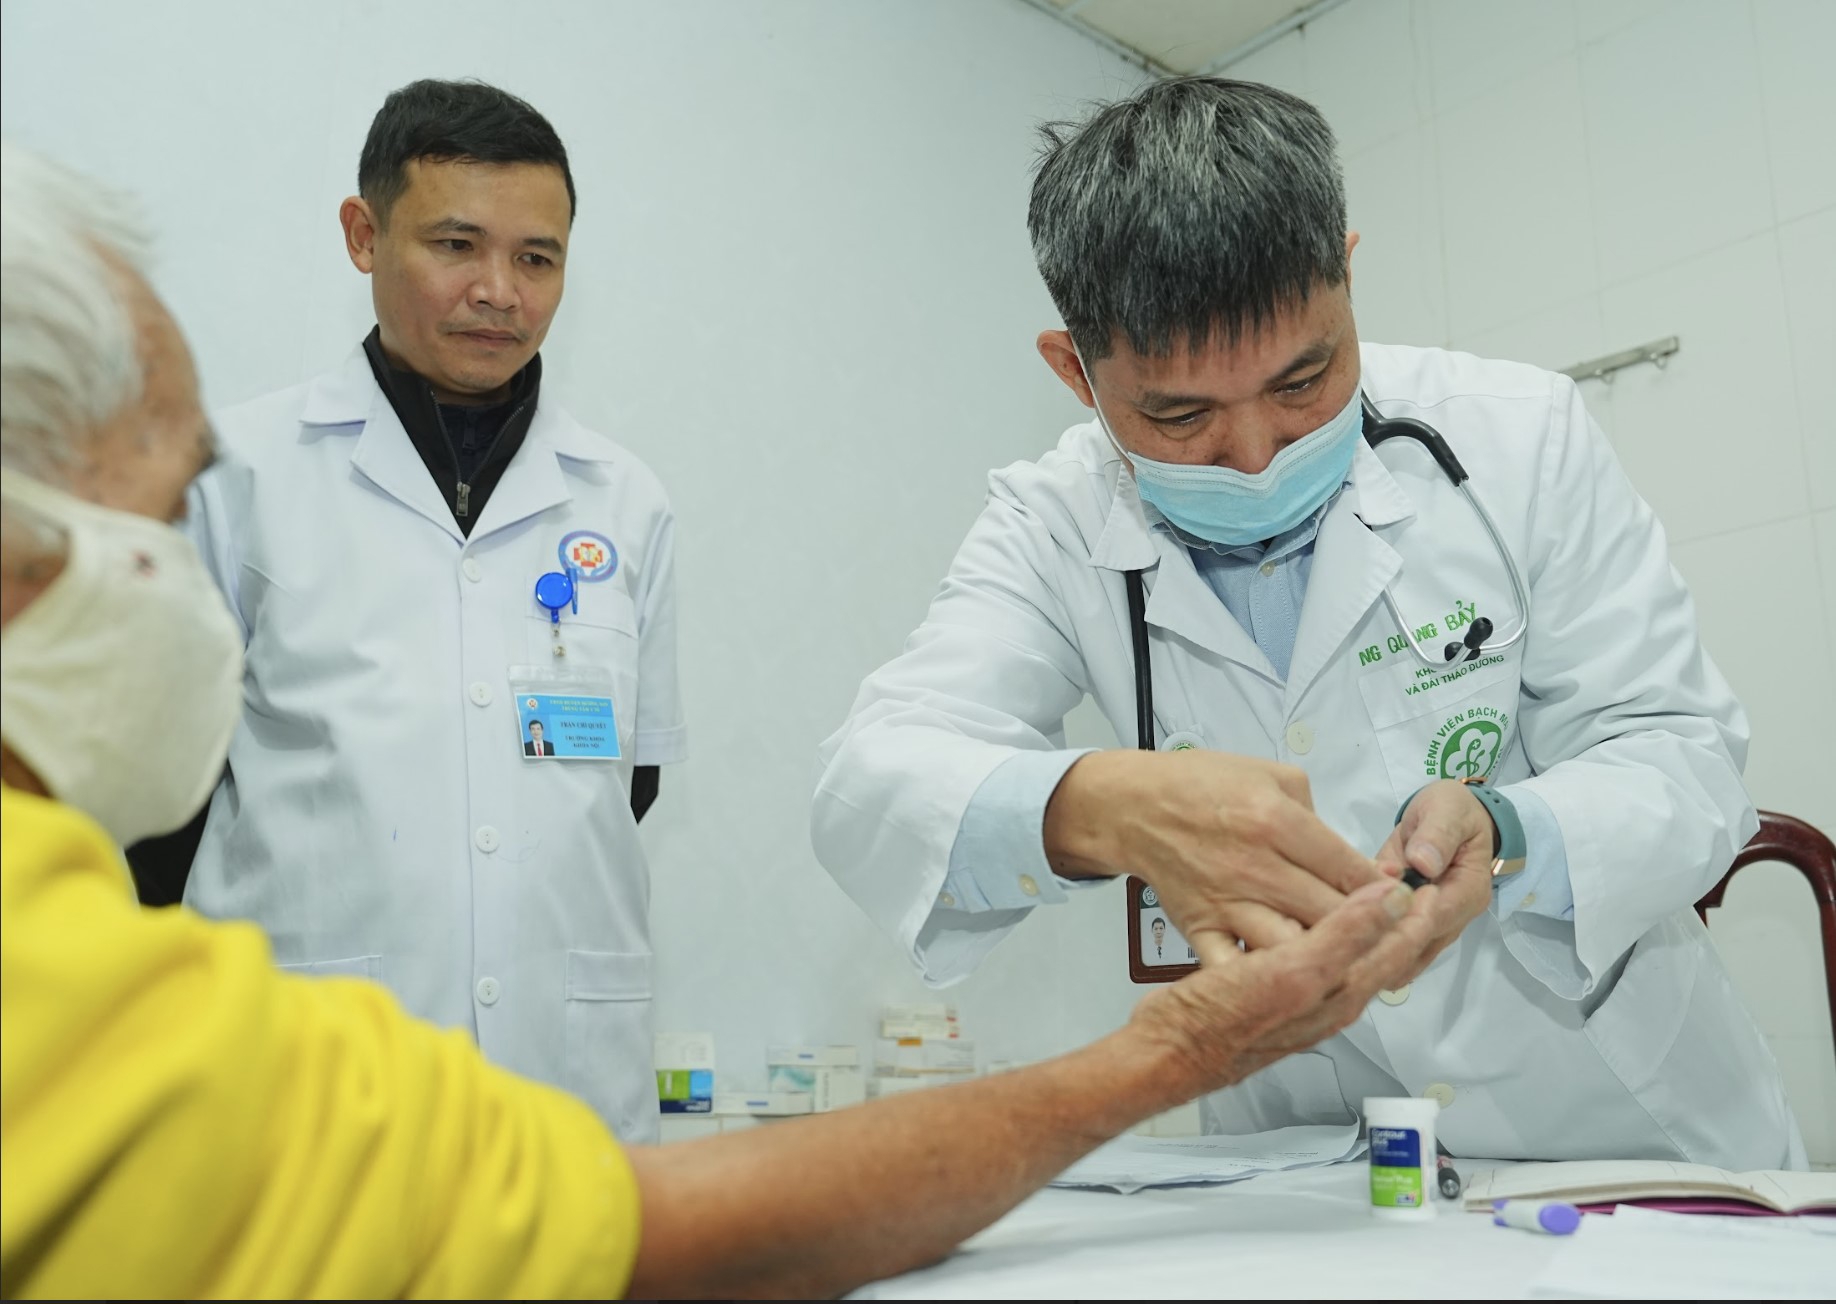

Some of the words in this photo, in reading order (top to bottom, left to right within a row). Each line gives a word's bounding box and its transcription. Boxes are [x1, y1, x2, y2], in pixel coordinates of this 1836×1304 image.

[1359, 645, 1382, 666] NG
[1387, 623, 1438, 653] QUNG
[1444, 600, 1477, 631] BẢY
[1405, 683, 1420, 696] VÀ
[1424, 740, 1441, 775] BỆNH
[1437, 713, 1465, 738] VIỆN
[1467, 706, 1498, 720] BẠCH
